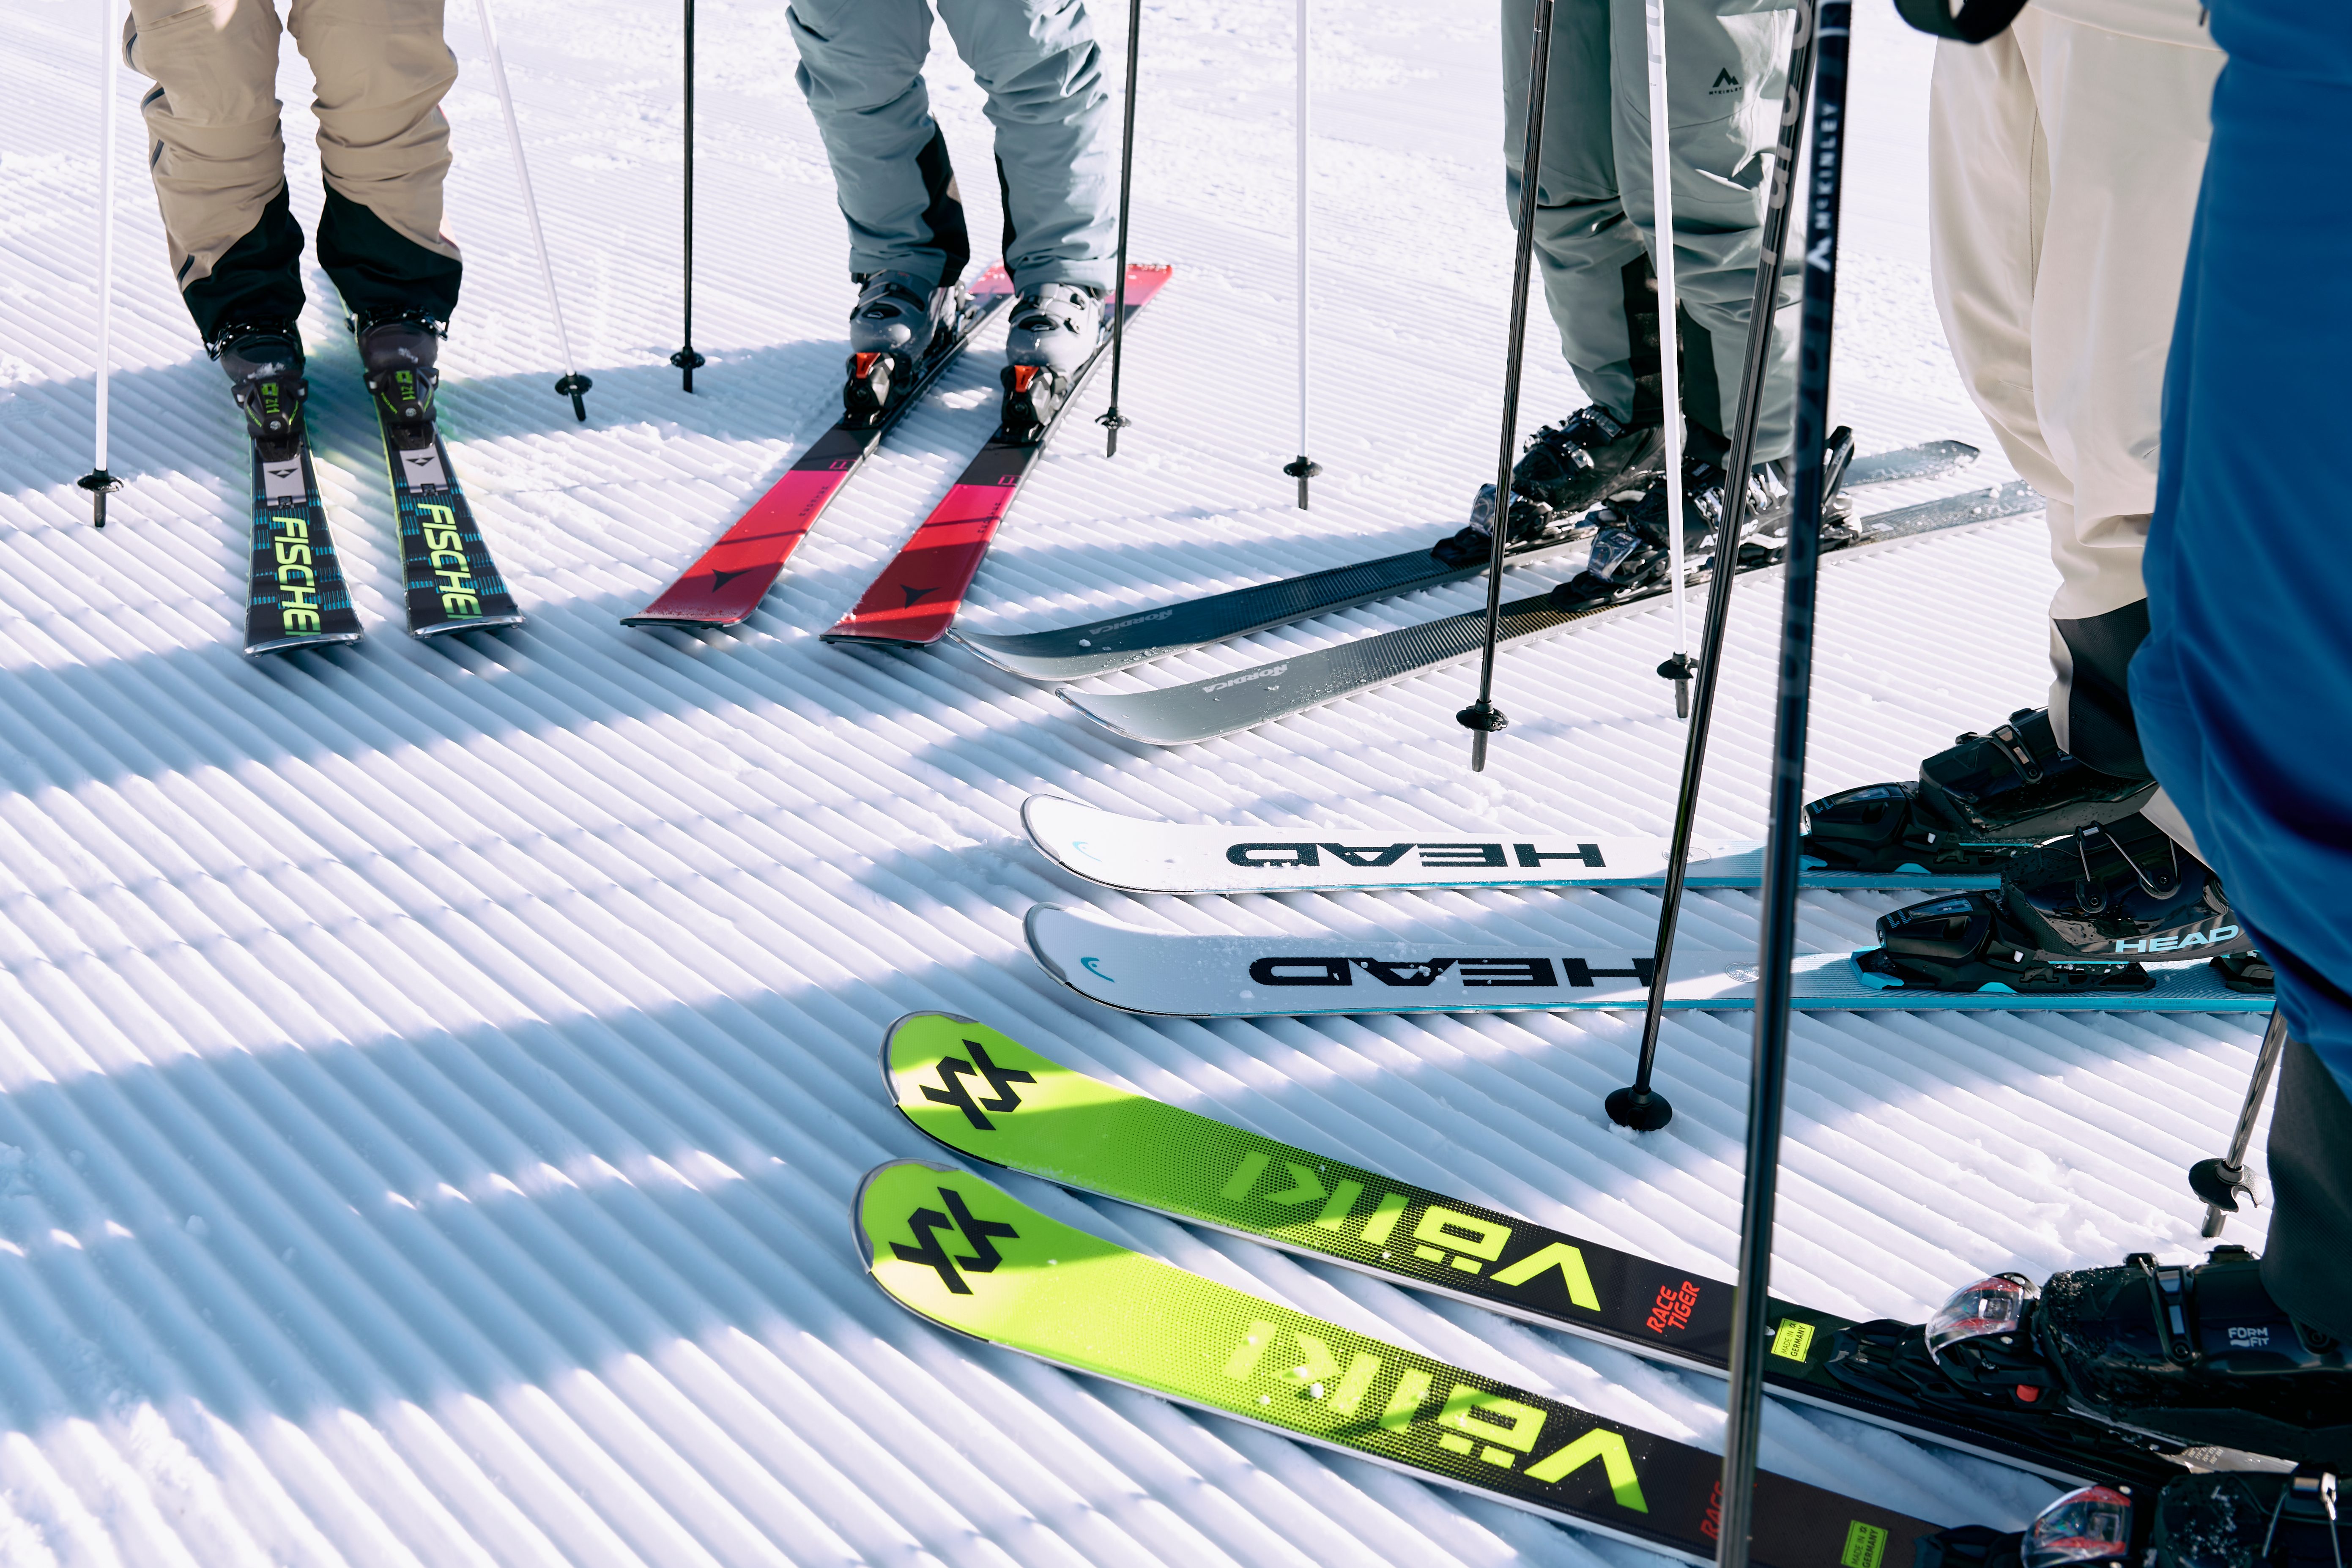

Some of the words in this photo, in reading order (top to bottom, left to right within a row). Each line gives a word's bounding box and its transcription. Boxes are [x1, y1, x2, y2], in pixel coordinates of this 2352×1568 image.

[1227, 843, 1607, 867] HEAD
[2115, 925, 2239, 952] HEAD
[1249, 957, 1654, 987] HEAD
[1646, 1285, 1677, 1334] RACE
[1667, 1281, 1700, 1330] TIGER
[1781, 1338, 1792, 1355] MADE
[1791, 1325, 1806, 1357] GERMANY
[2228, 1327, 2268, 1338] FORM
[2250, 1336, 2270, 1347] FIT
[1862, 1528, 1878, 1568] GERMANY
